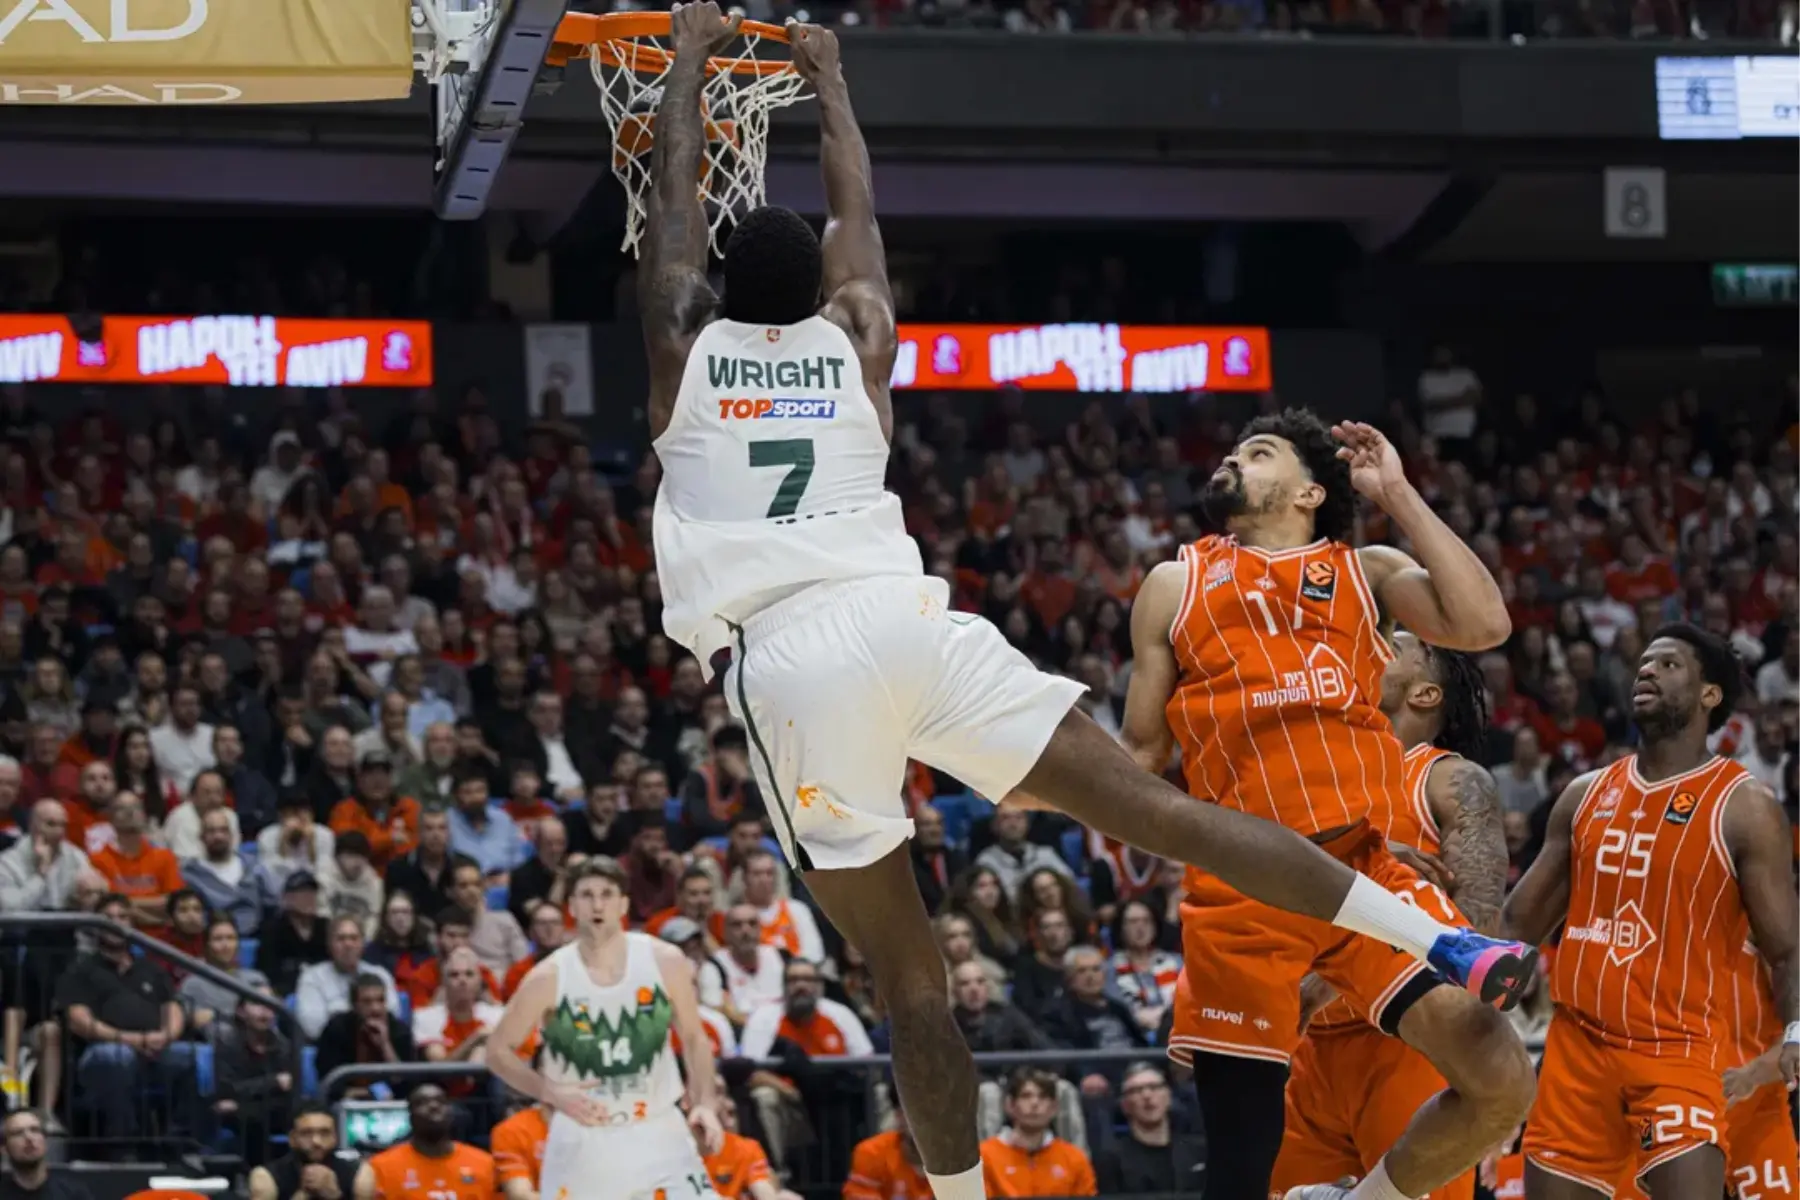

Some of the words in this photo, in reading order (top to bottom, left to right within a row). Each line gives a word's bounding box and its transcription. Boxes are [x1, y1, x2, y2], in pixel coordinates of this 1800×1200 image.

[707, 354, 846, 390] WRIGHT
[718, 398, 835, 419] TOPsport
[748, 437, 816, 518] 7
[1309, 665, 1348, 699] IBI
[1595, 828, 1657, 878] 25
[598, 1036, 633, 1067] 14
[1655, 1103, 1719, 1145] 25
[1733, 1158, 1792, 1200] 24
